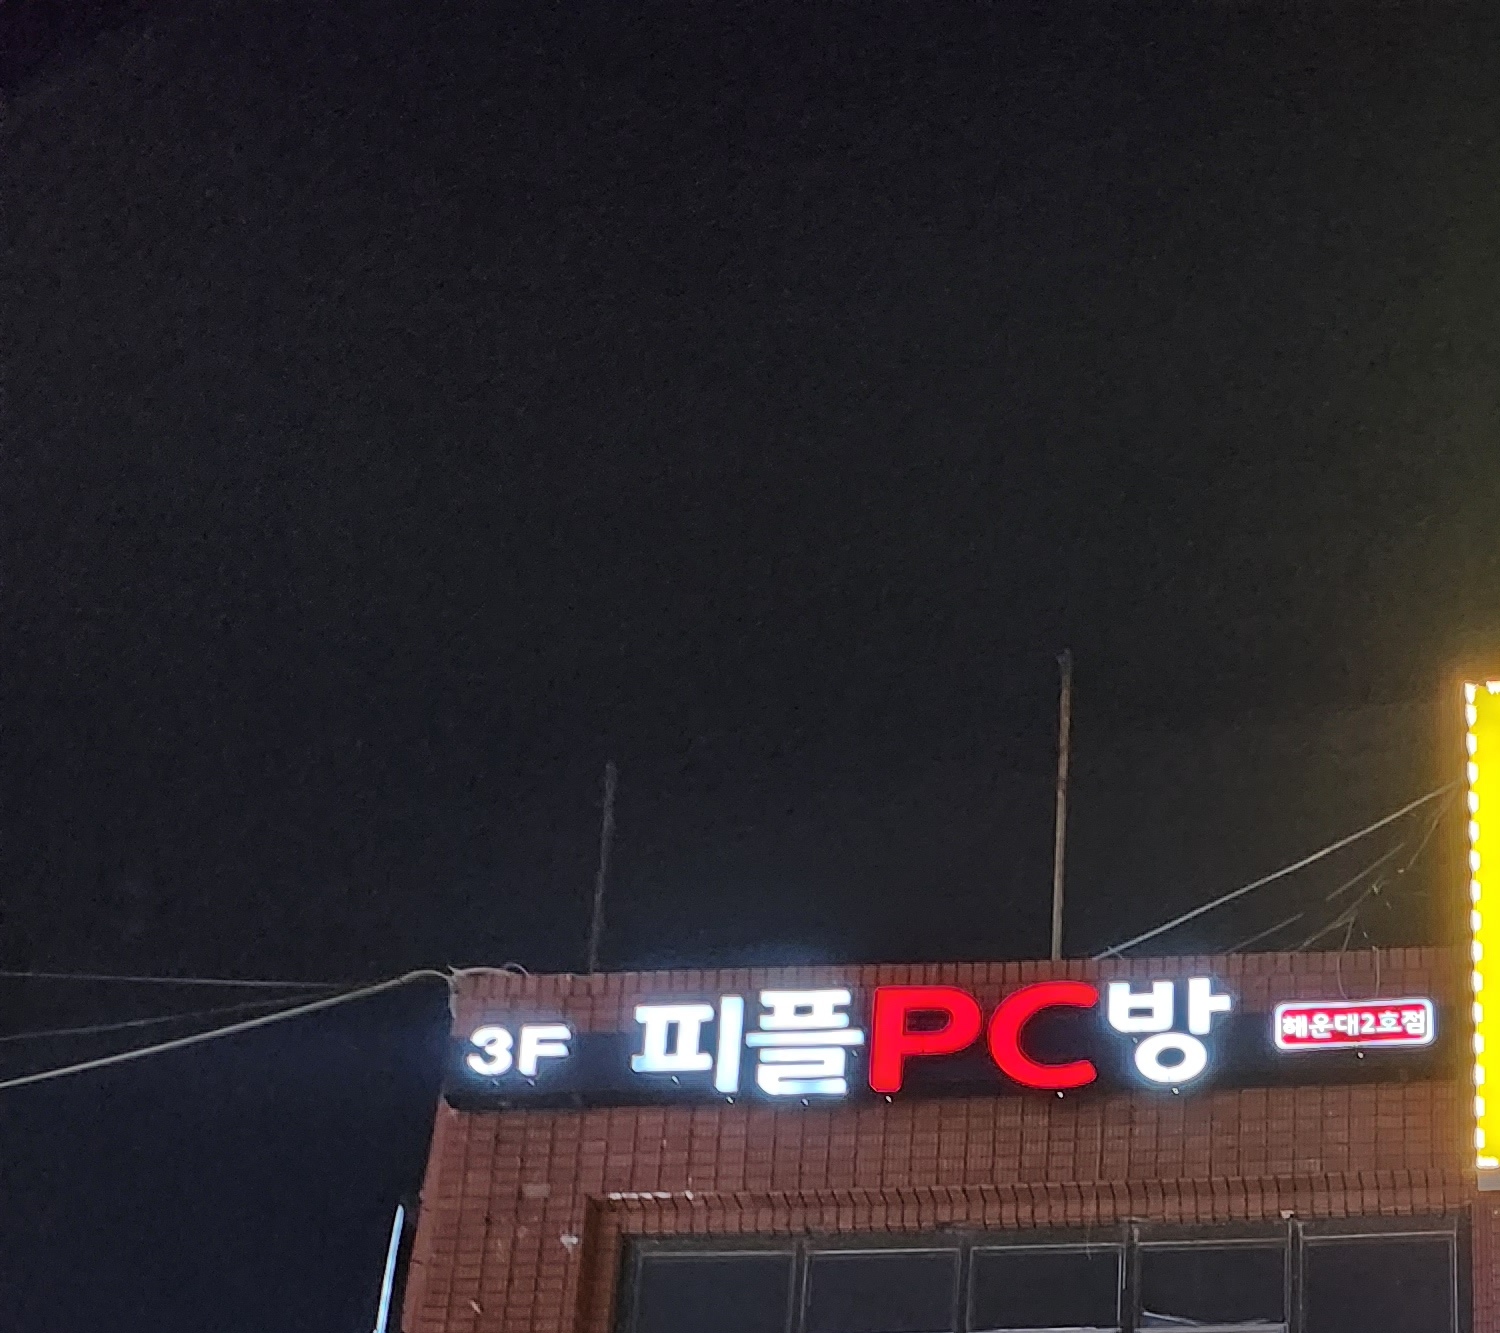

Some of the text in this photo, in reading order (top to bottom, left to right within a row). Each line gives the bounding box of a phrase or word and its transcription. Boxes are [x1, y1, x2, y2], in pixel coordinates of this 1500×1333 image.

[466, 977, 1428, 1099] 3F 피플PC방 해운대2호점
